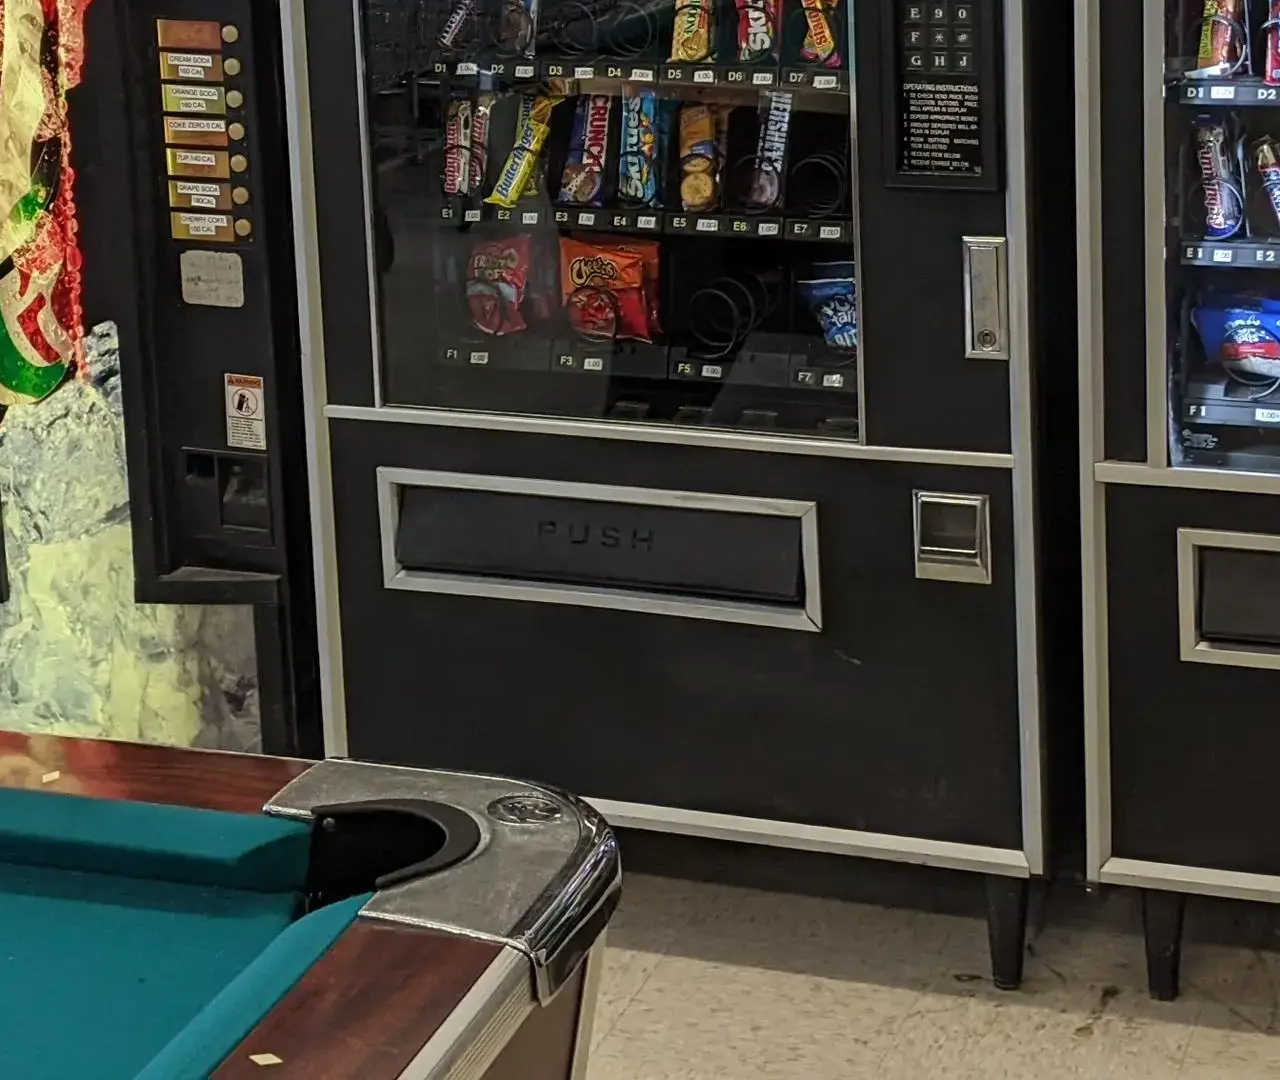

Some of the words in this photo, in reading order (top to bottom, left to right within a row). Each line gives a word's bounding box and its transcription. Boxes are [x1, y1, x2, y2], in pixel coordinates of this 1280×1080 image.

[549, 66, 562, 75] D3
[668, 70, 681, 78] D5
[1188, 88, 1203, 98] D1
[1258, 89, 1276, 99] D2
[556, 212, 567, 221] E3
[673, 218, 686, 227] E5
[1188, 248, 1203, 258] E1
[1257, 251, 1274, 261] E2
[570, 255, 617, 287] Cheetos
[561, 356, 572, 365] F3
[1189, 406, 1206, 416] F1
[537, 521, 656, 552] PUSH
